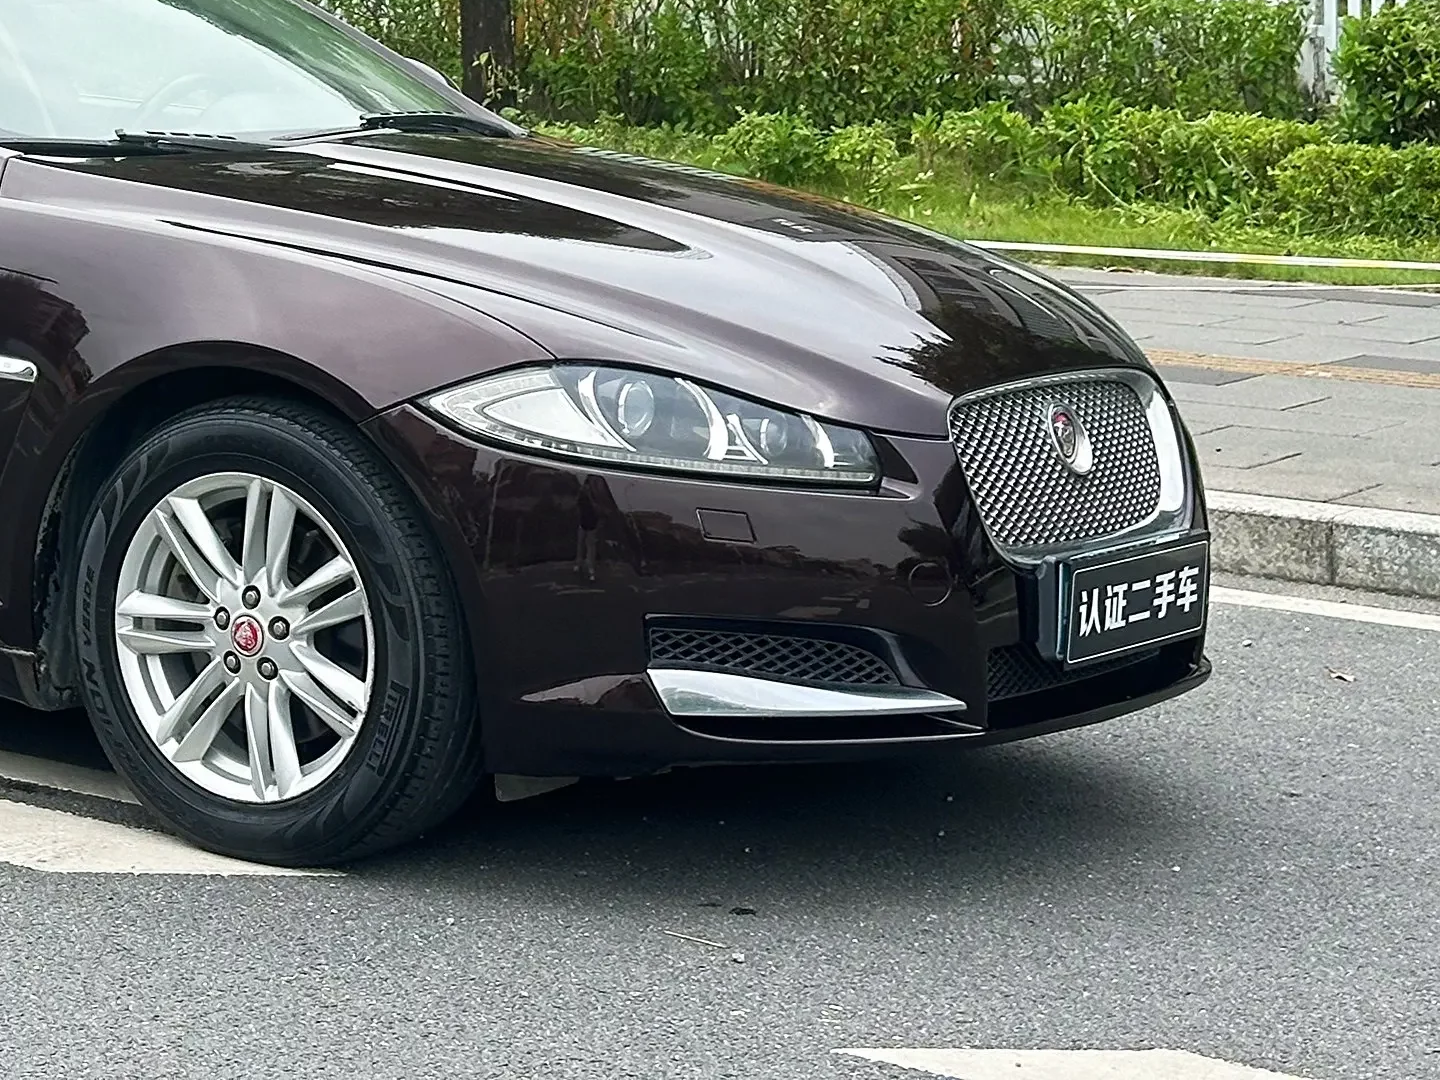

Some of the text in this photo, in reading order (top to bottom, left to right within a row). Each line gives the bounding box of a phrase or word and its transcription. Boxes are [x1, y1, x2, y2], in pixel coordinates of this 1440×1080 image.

[82, 565, 96, 646] VERDE
[1078, 565, 1200, 637] 认证二手车
